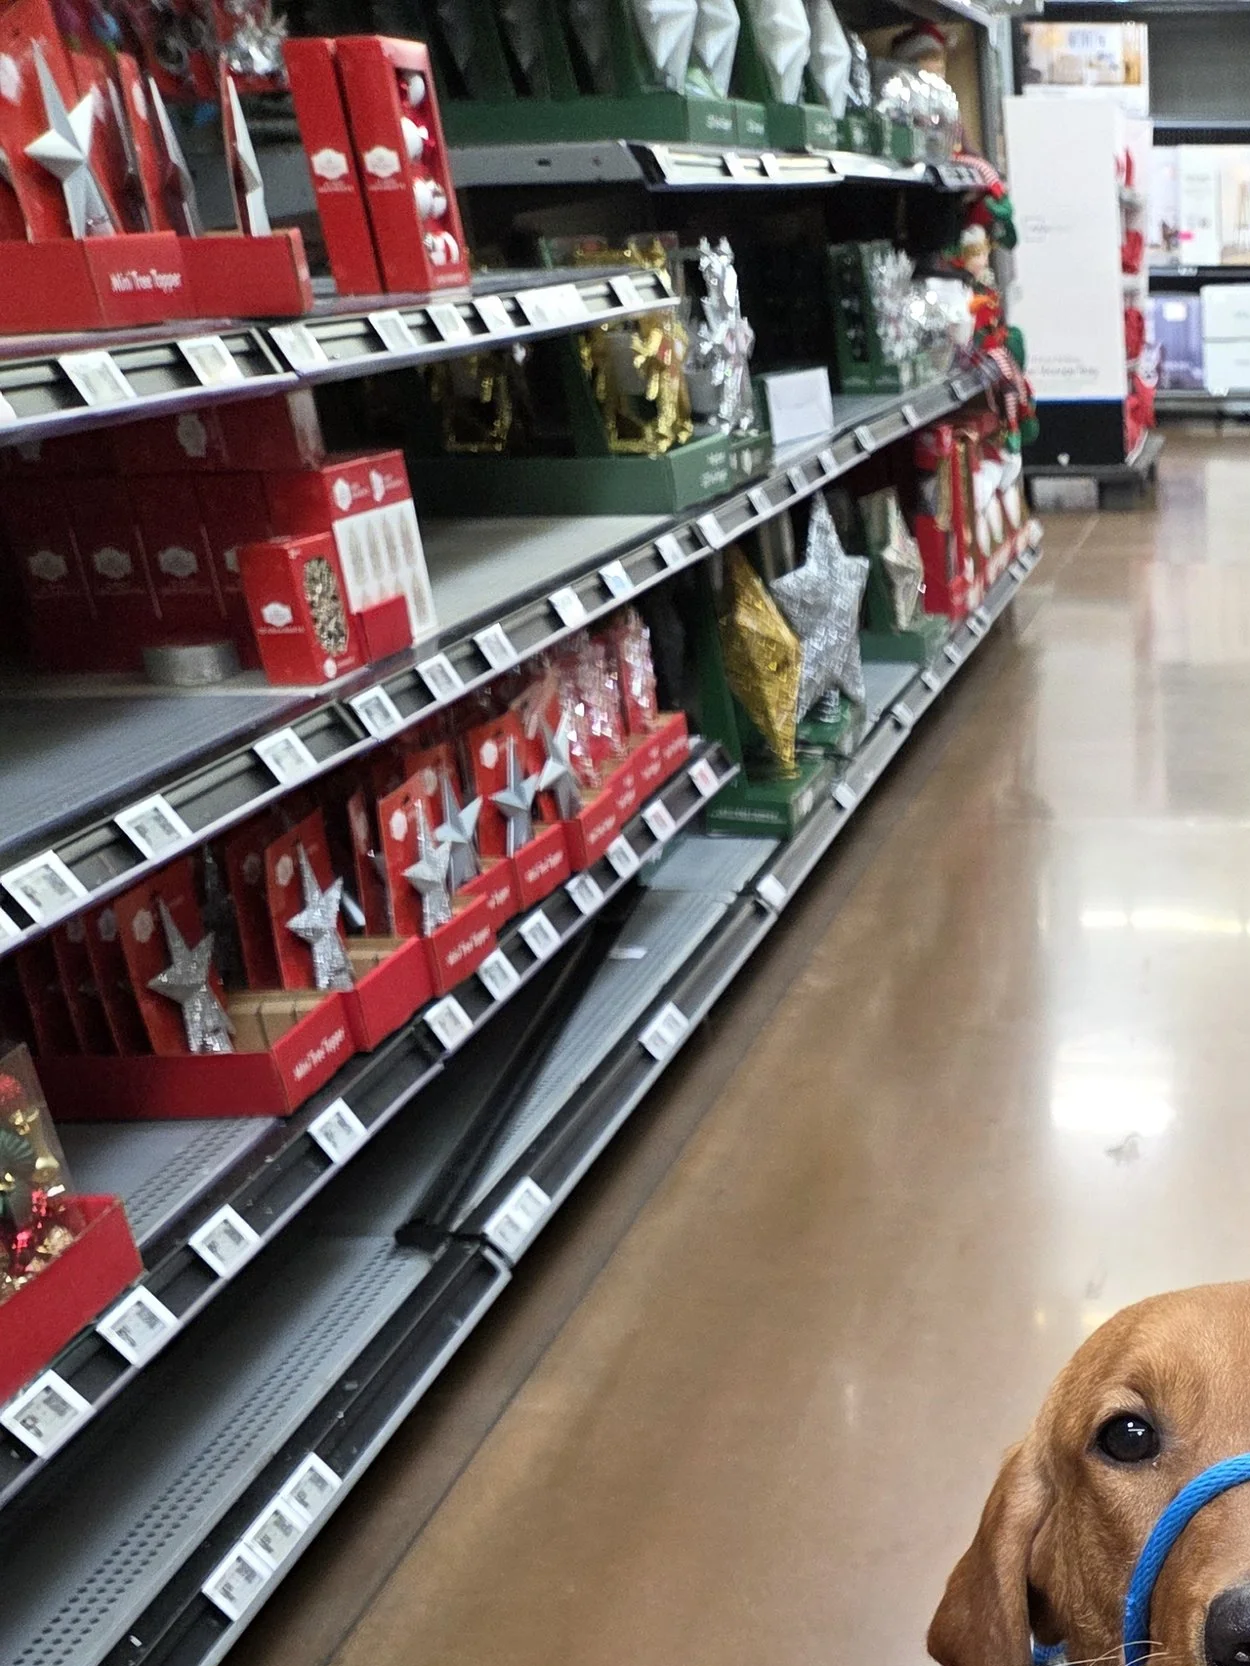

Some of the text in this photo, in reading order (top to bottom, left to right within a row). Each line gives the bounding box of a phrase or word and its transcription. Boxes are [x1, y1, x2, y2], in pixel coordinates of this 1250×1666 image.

[109, 267, 182, 295] Mini Tree Topper
